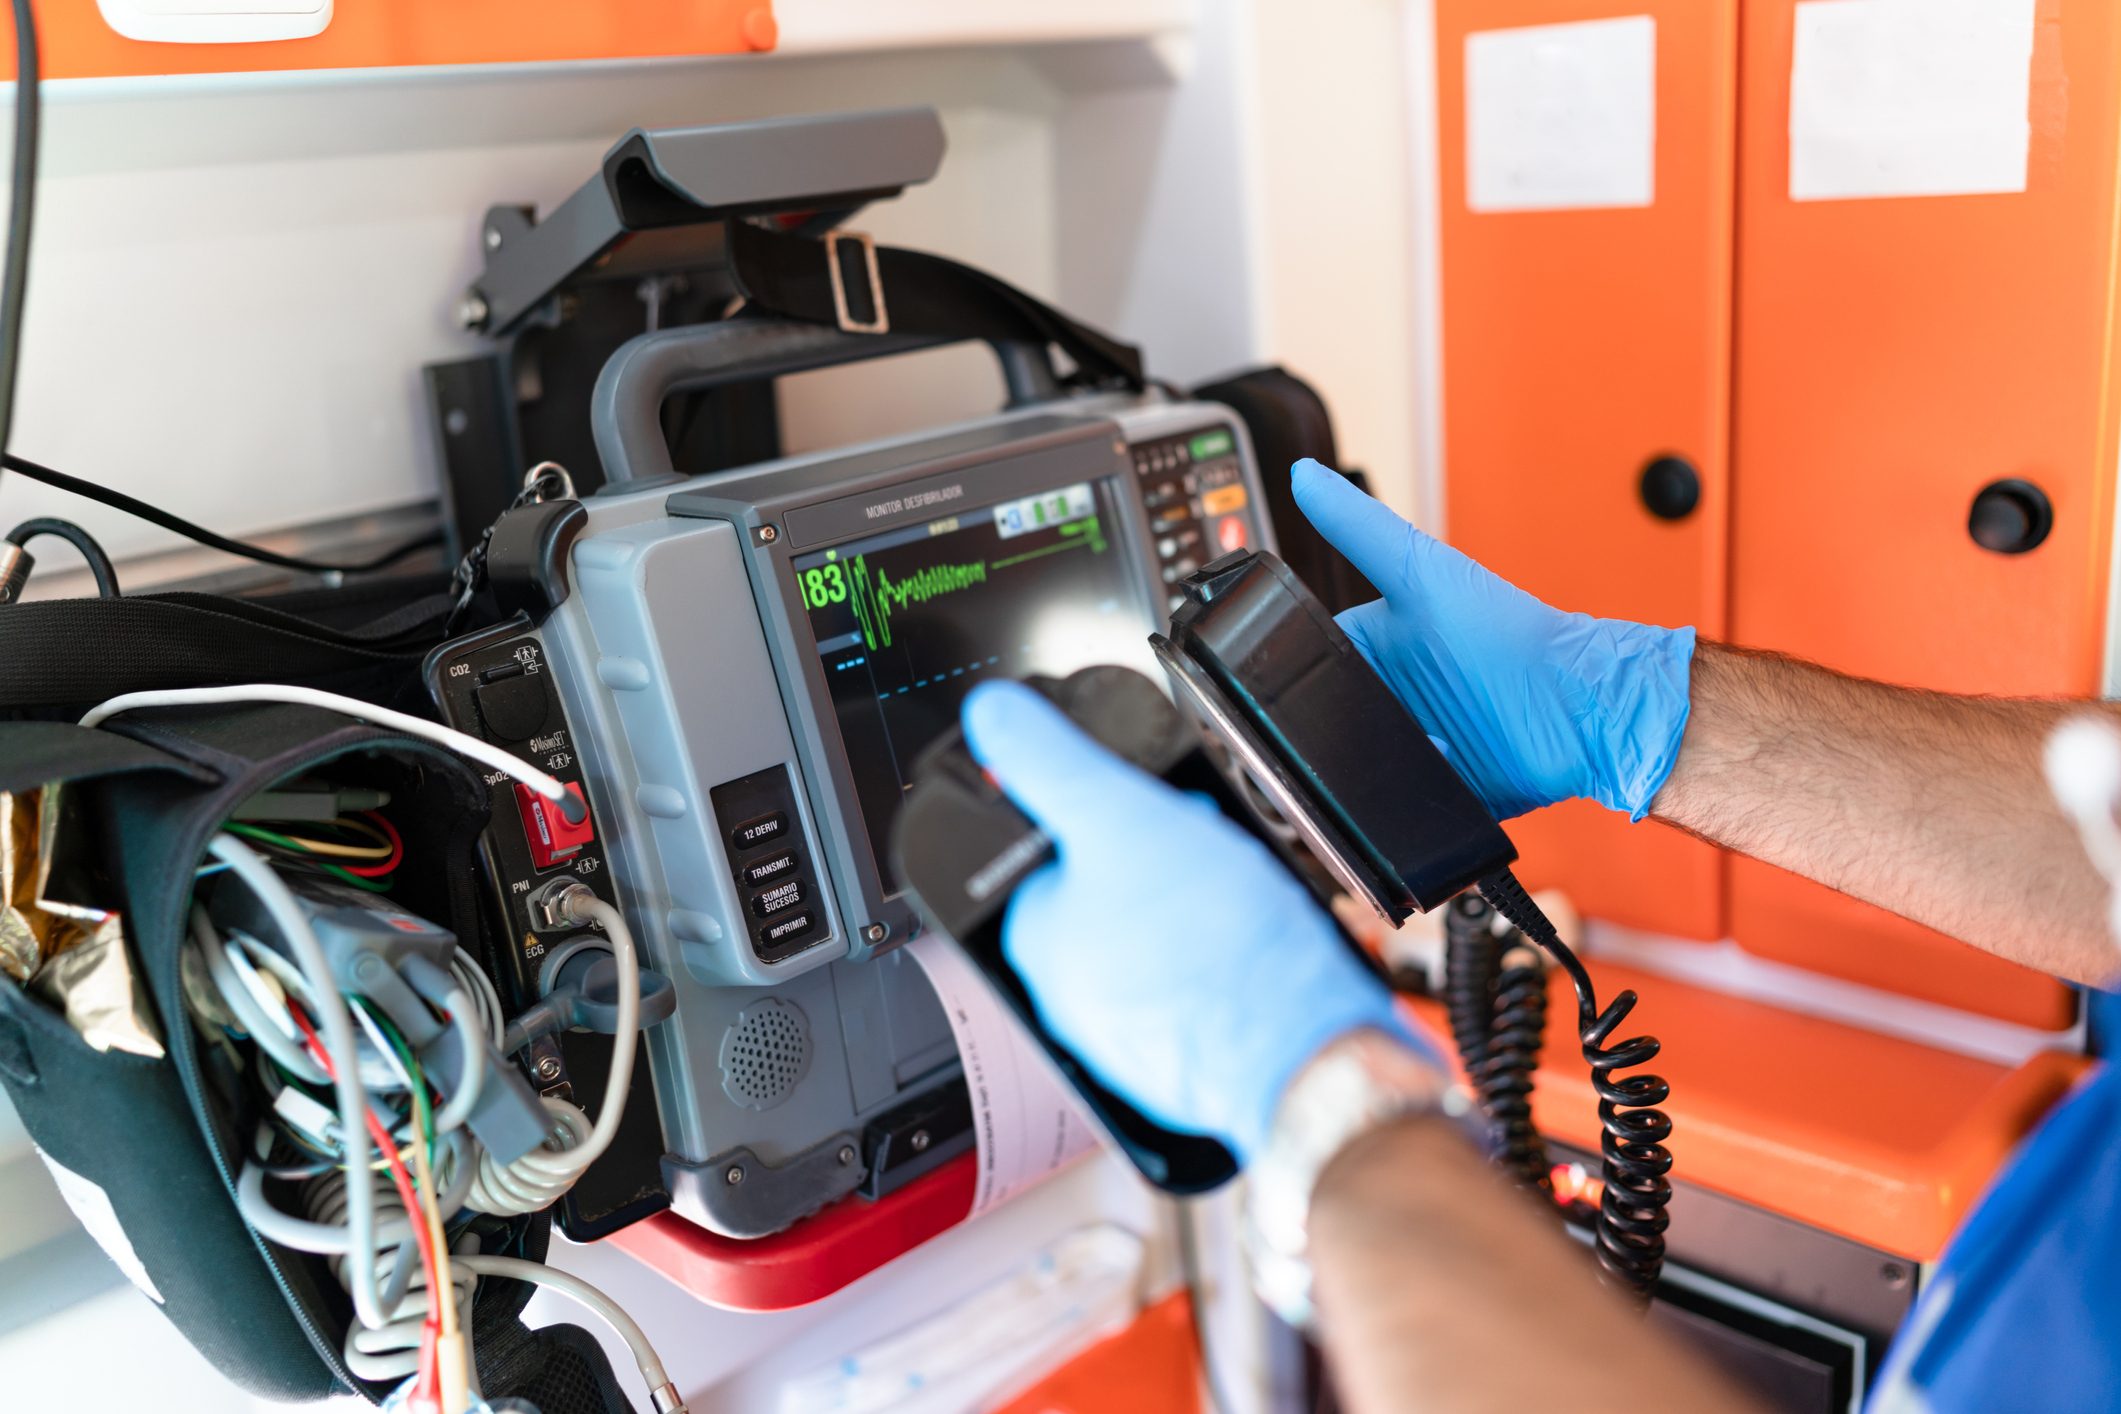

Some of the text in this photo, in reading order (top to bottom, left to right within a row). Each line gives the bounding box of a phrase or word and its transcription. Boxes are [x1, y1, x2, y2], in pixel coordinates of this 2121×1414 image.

[865, 485, 963, 519] MONITOR DESFIBRILADOR
[450, 663, 471, 677] CO2
[483, 771, 509, 786] SpO2
[743, 820, 778, 840] 12 DERIV
[751, 857, 794, 879] TRANSMIT.
[512, 879, 531, 894] PNI
[762, 882, 798, 903] SUMARIO
[765, 892, 800, 913] SUCESOS
[770, 916, 808, 939] IMPRIMIR
[525, 944, 545, 959] ECG
